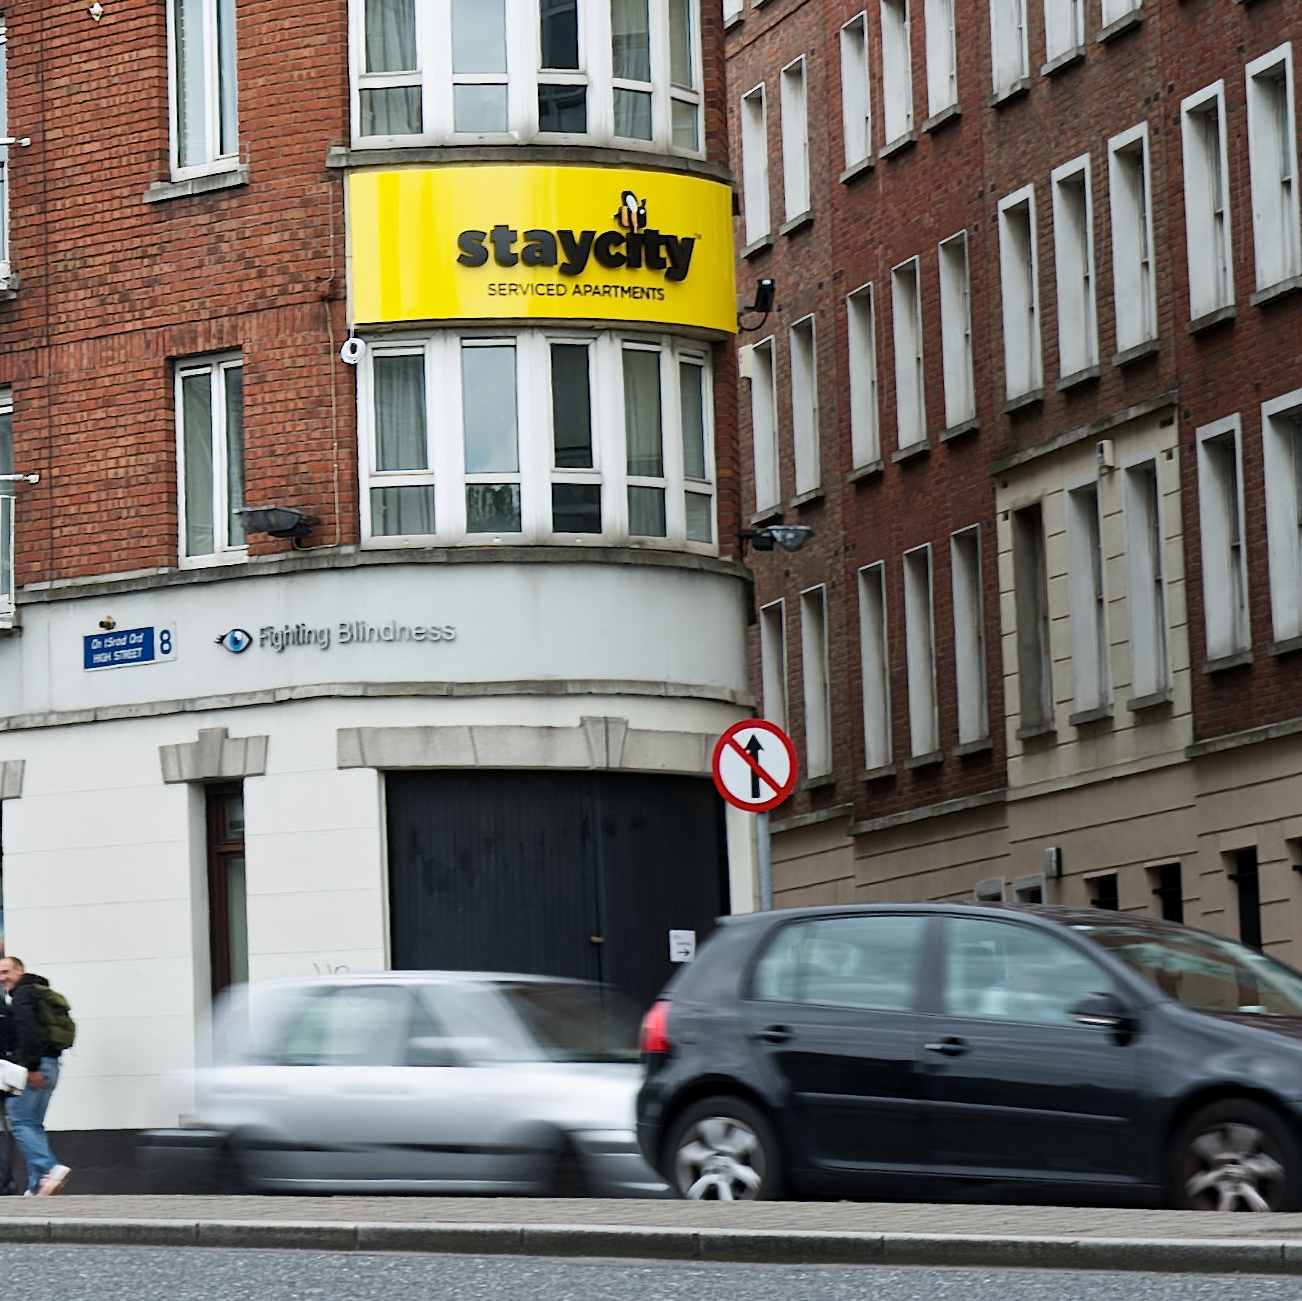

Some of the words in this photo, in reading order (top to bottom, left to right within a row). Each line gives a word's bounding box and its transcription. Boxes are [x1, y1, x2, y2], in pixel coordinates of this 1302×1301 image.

[457, 224, 695, 282] staycity
[487, 283, 568, 297] SERVICED
[571, 284, 666, 301] APARTMENTS
[159, 629, 172, 655] 8
[259, 623, 331, 653] Fighting
[338, 620, 456, 644] Blindness
[92, 651, 112, 664] HIGH
[113, 647, 143, 661] STREET
